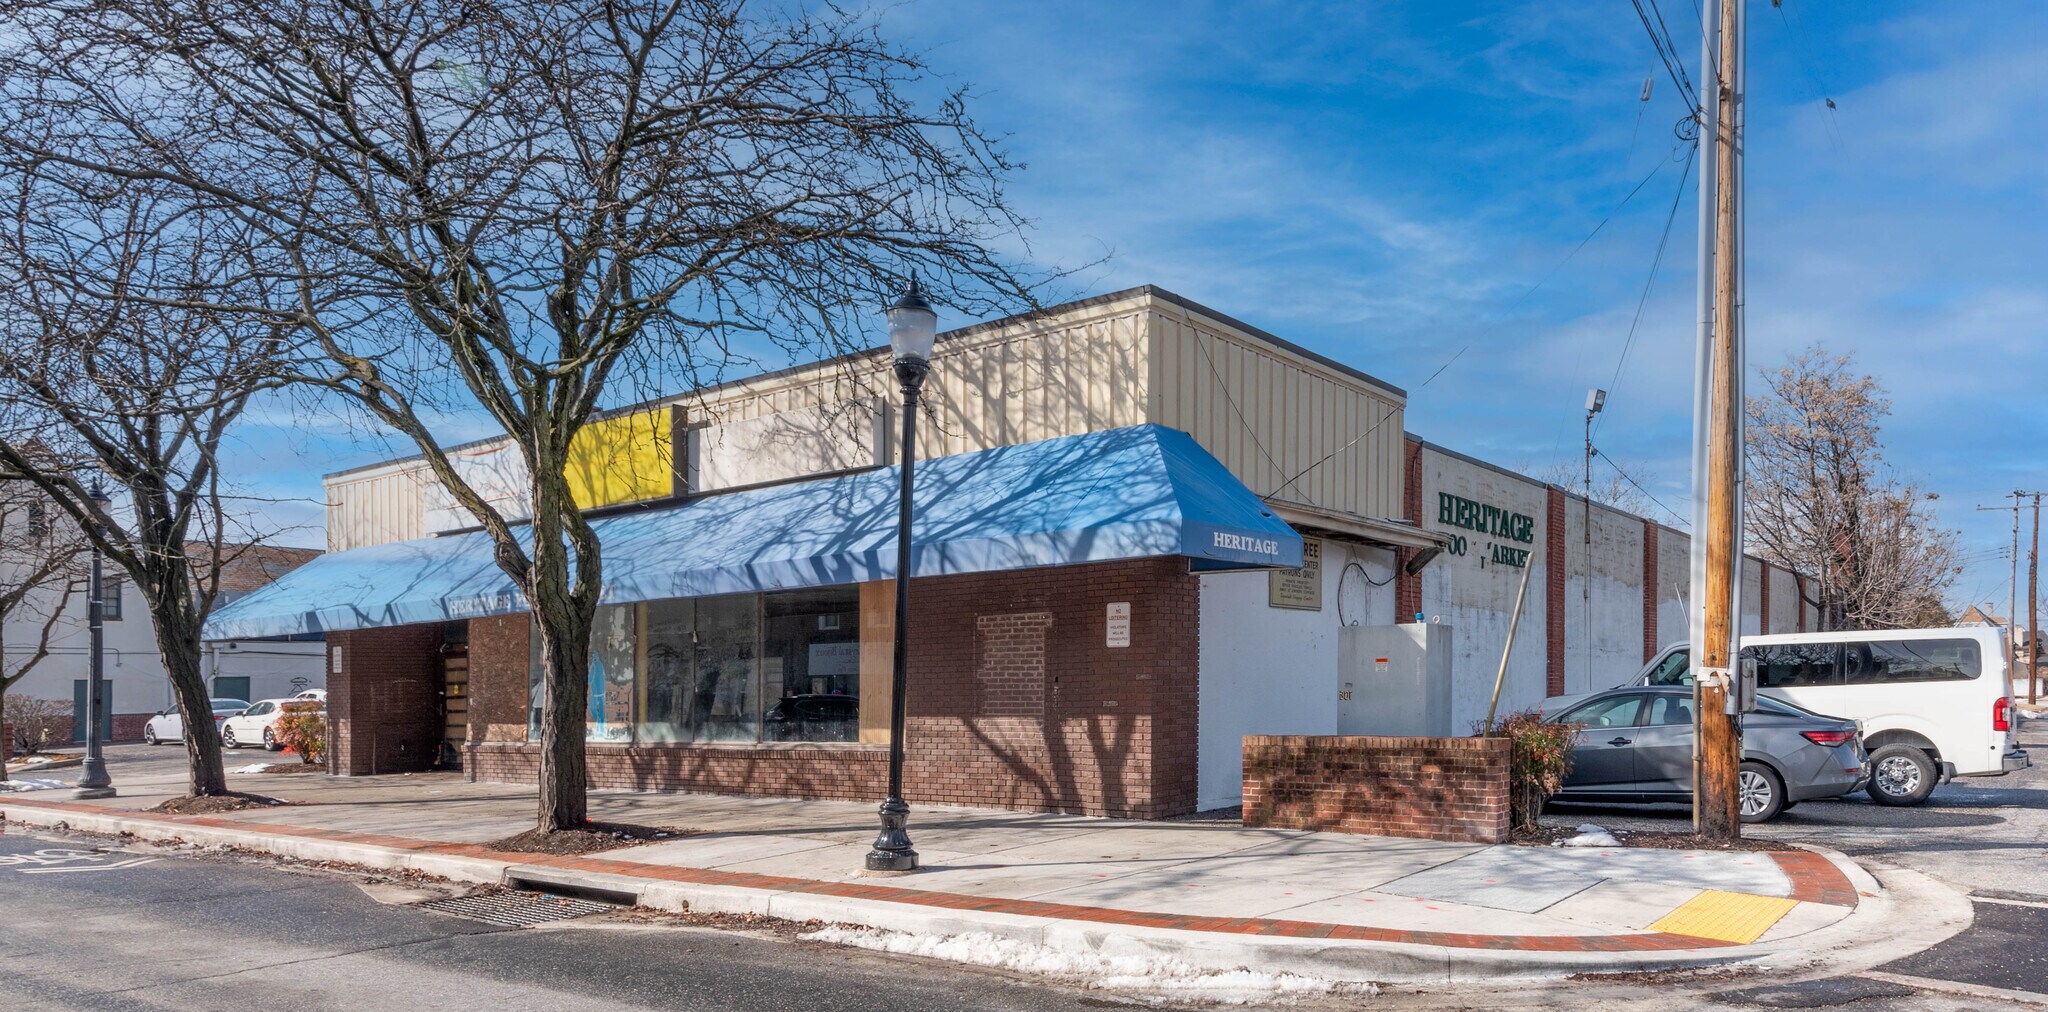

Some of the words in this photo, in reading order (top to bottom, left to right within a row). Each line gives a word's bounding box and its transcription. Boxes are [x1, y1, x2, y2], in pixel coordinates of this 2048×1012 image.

[1438, 491, 1534, 544] HERITAGE
[1213, 532, 1279, 556] HERITAGE
[1304, 542, 1319, 558] REE
[1304, 560, 1319, 570] ENTER
[1302, 570, 1315, 579] ONLY
[449, 593, 511, 614] HERITAGE
